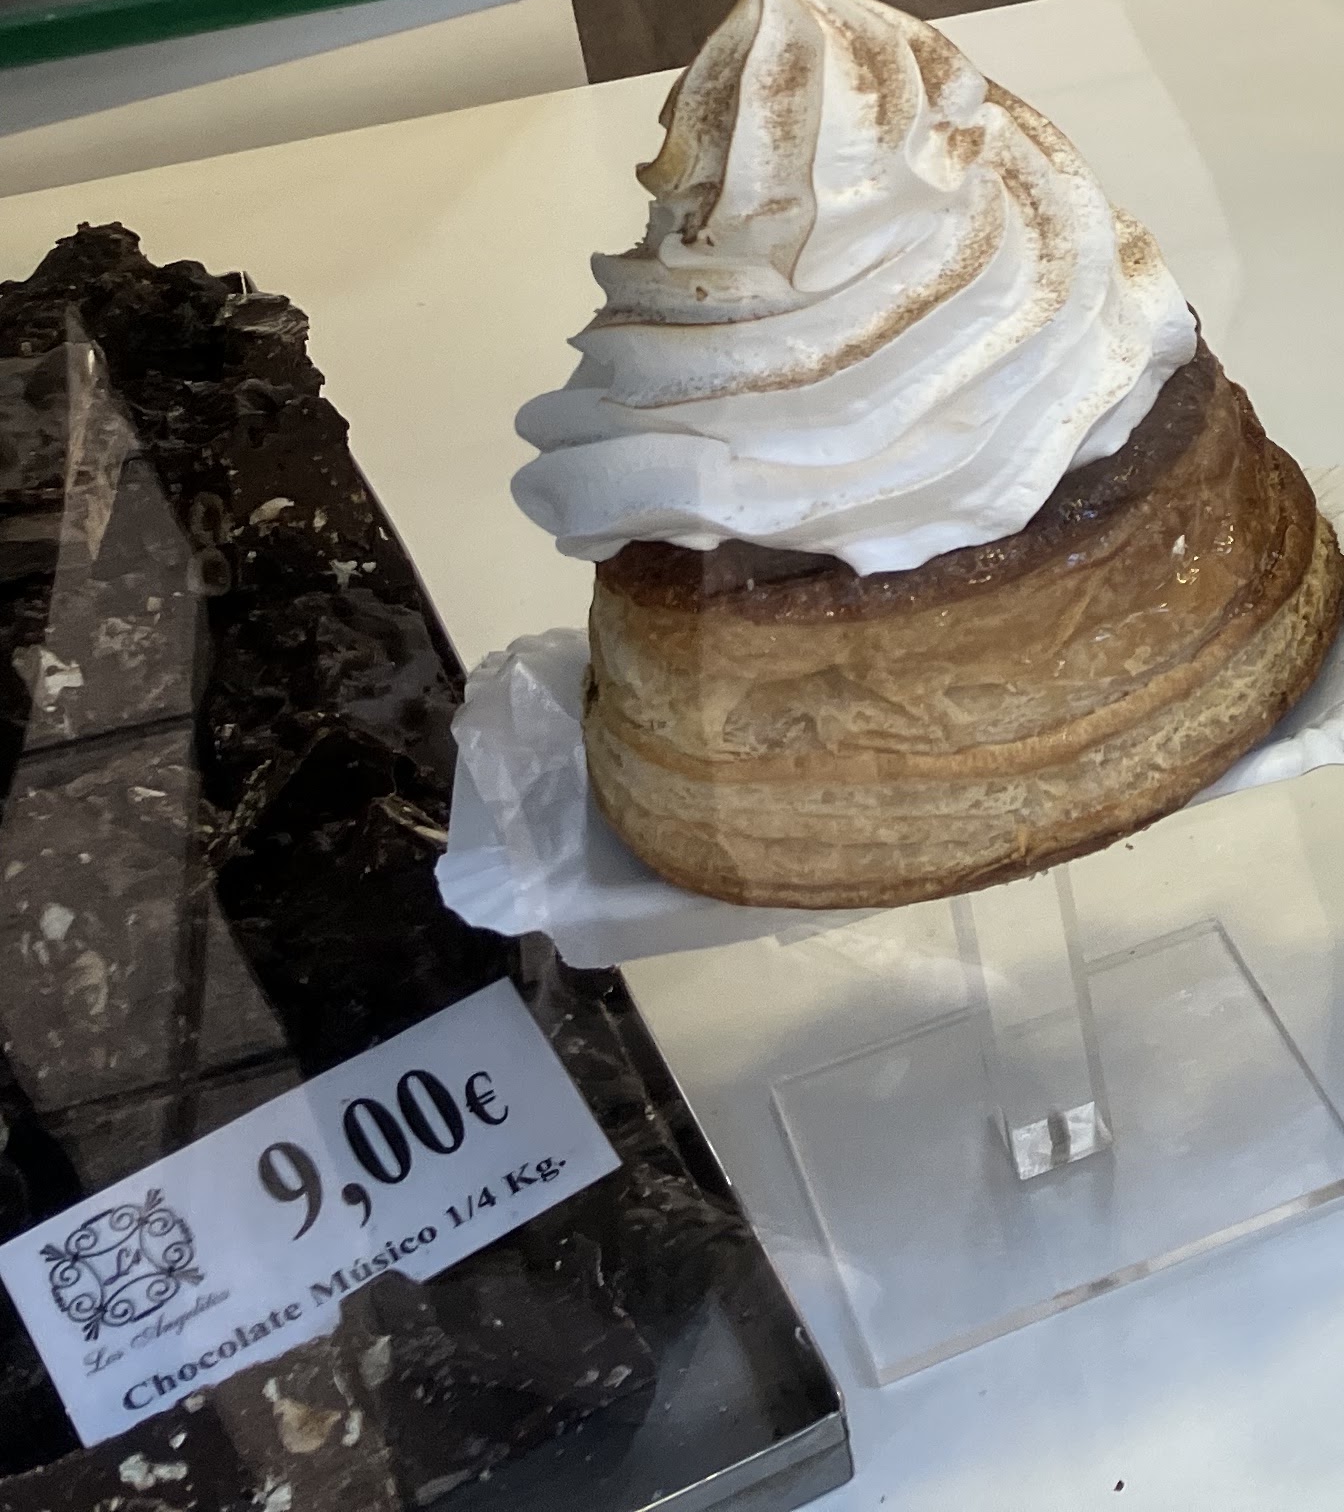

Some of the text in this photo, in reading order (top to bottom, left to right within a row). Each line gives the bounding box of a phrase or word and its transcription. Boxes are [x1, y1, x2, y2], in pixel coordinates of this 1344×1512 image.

[257, 1069, 509, 1242] 9,00€
[122, 1156, 567, 1411] Chocolate Músico 1/4 Kg.
